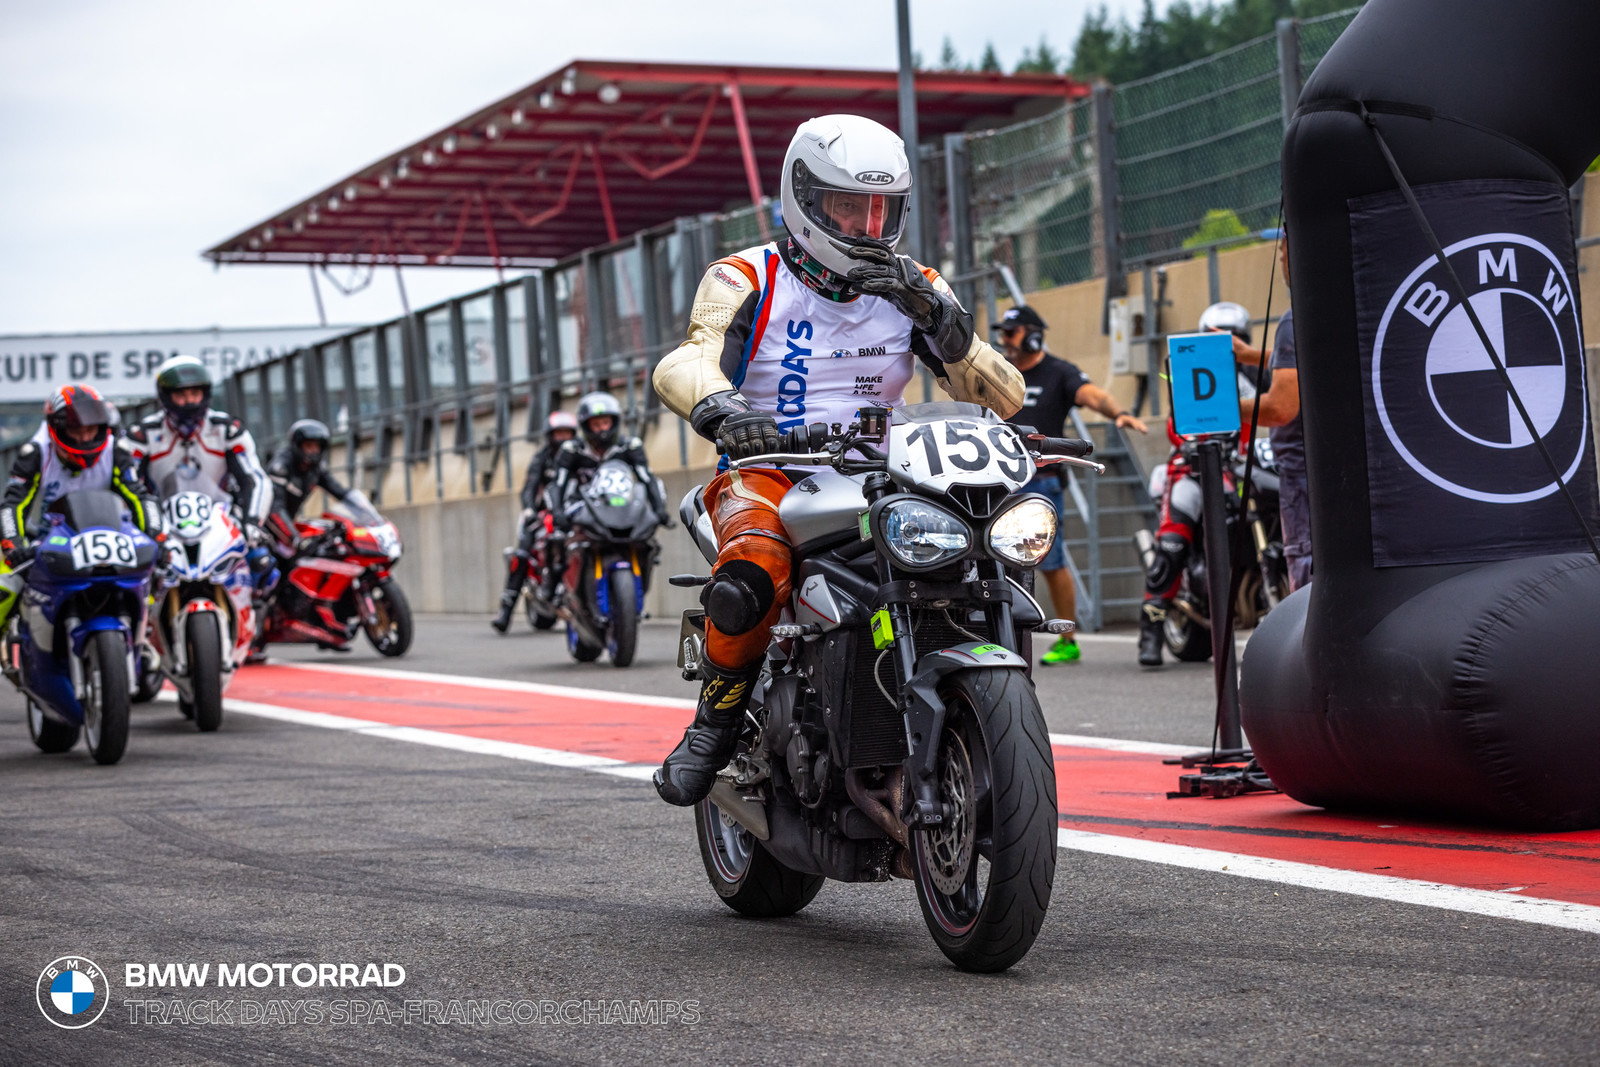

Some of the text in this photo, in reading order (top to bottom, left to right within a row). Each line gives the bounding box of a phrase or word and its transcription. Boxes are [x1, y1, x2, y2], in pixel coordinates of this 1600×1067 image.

[861, 174, 889, 182] HJC
[1403, 248, 1568, 327] BMW
[0, 353, 57, 382] UIT
[70, 351, 112, 380] DE
[124, 350, 180, 379] SP
[858, 346, 886, 357] BMW
[1191, 367, 1216, 402] D
[906, 421, 1028, 483] 159
[73, 533, 133, 563] 158
[703, 675, 725, 702] TCX
